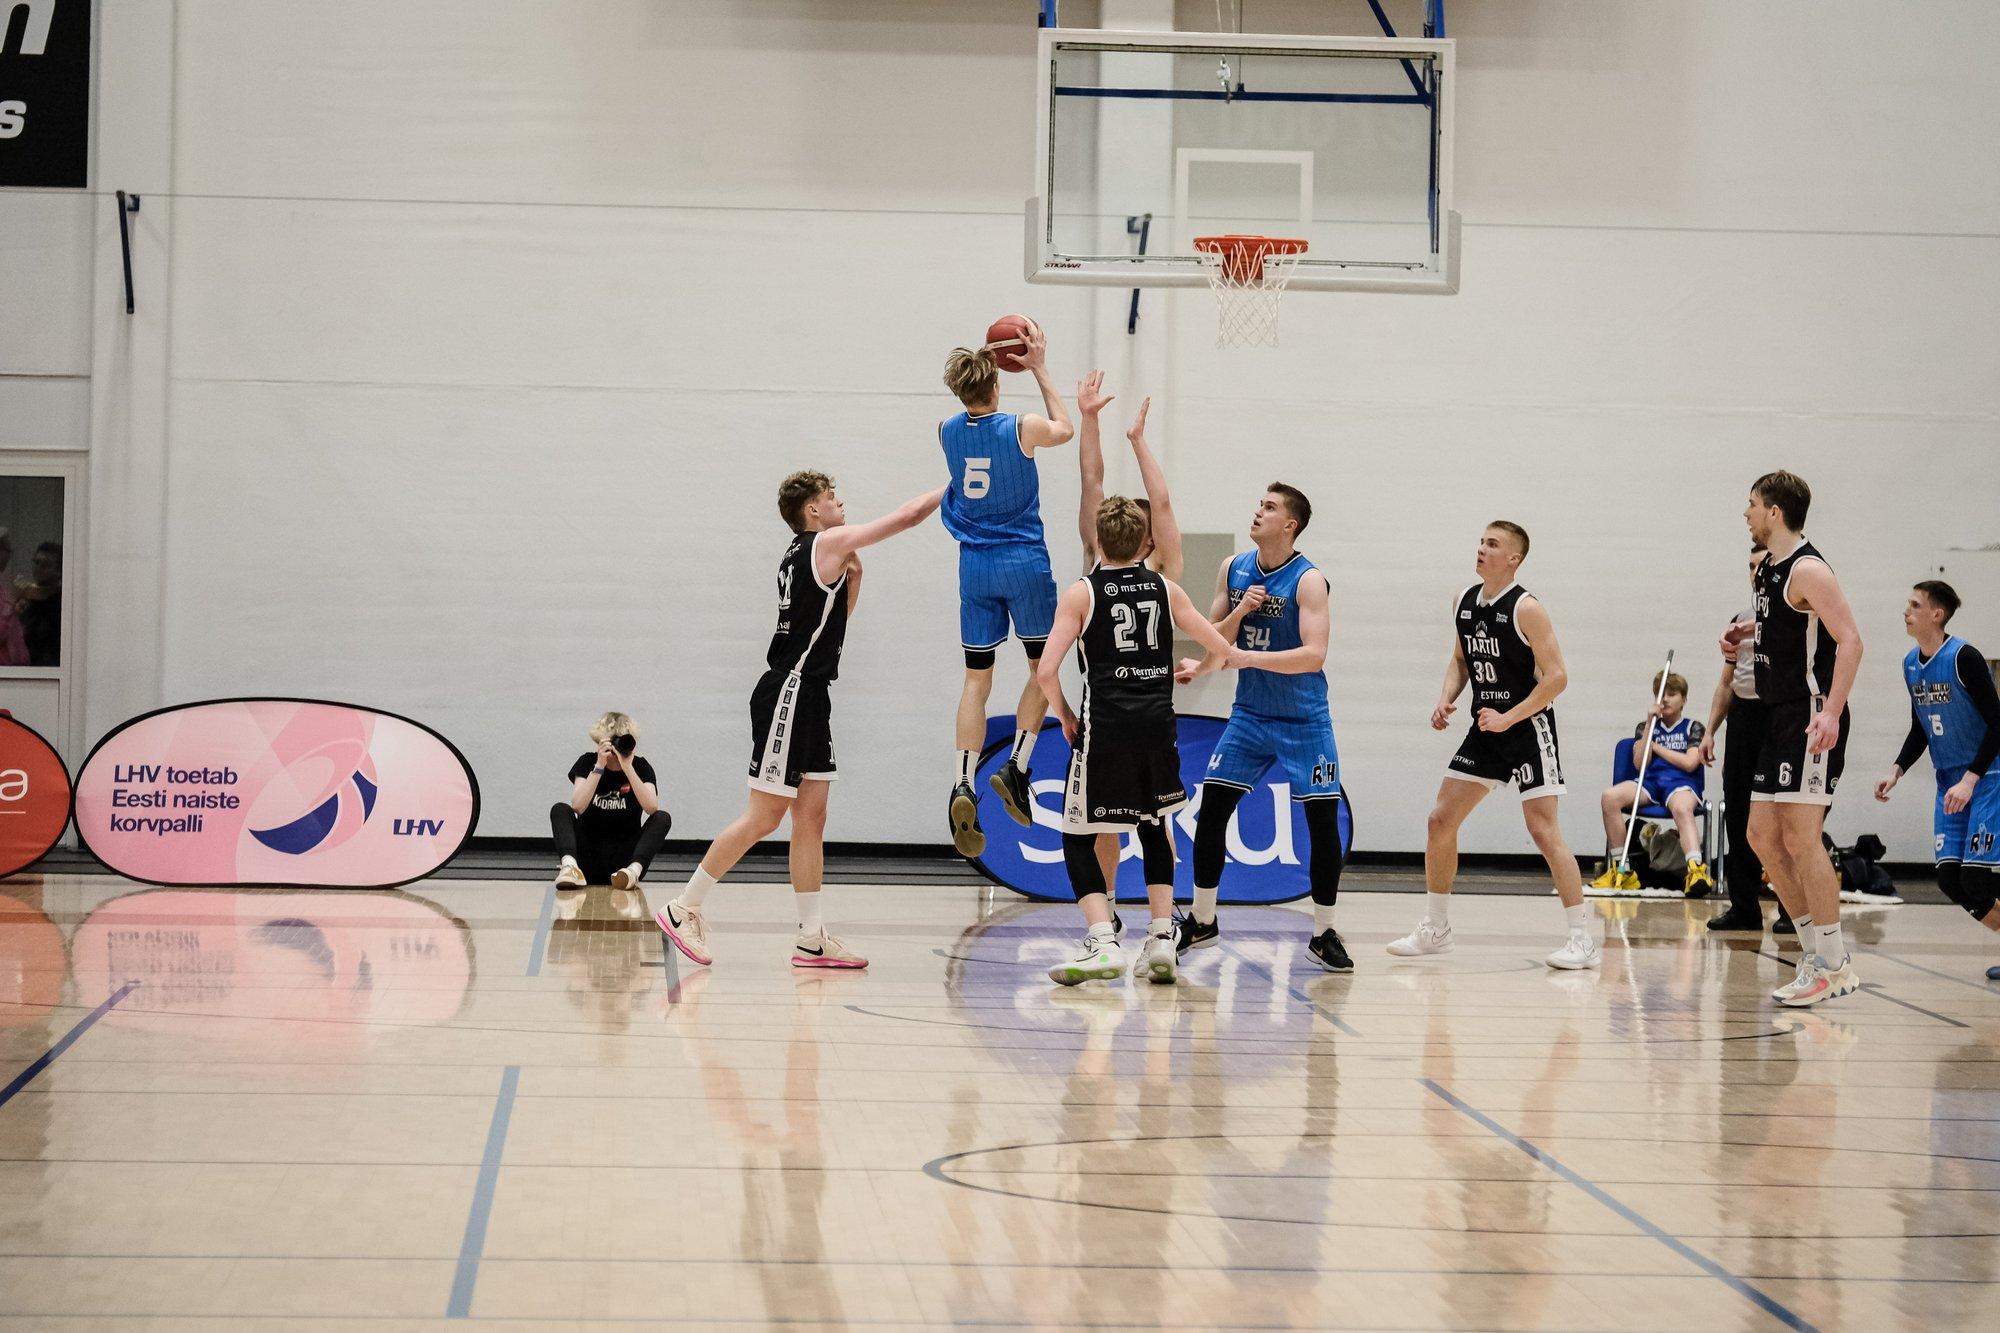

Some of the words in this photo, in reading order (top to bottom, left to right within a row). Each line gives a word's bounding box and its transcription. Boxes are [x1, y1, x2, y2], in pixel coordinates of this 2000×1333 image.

[1120, 582, 1158, 593] METEC
[1110, 600, 1161, 652] 27
[1243, 624, 1271, 652] 34
[1463, 634, 1500, 658] TARTU
[1130, 665, 1169, 677] Terminal
[1473, 660, 1498, 684] 30
[1480, 690, 1511, 700] ESTIKO
[114, 765, 161, 783] LHV
[166, 766, 238, 785] toetab
[1779, 762, 1793, 787] 6
[112, 789, 167, 808] Eesti
[173, 790, 240, 809] naiste
[110, 814, 203, 836] korvpalli
[393, 819, 445, 836] LHV
